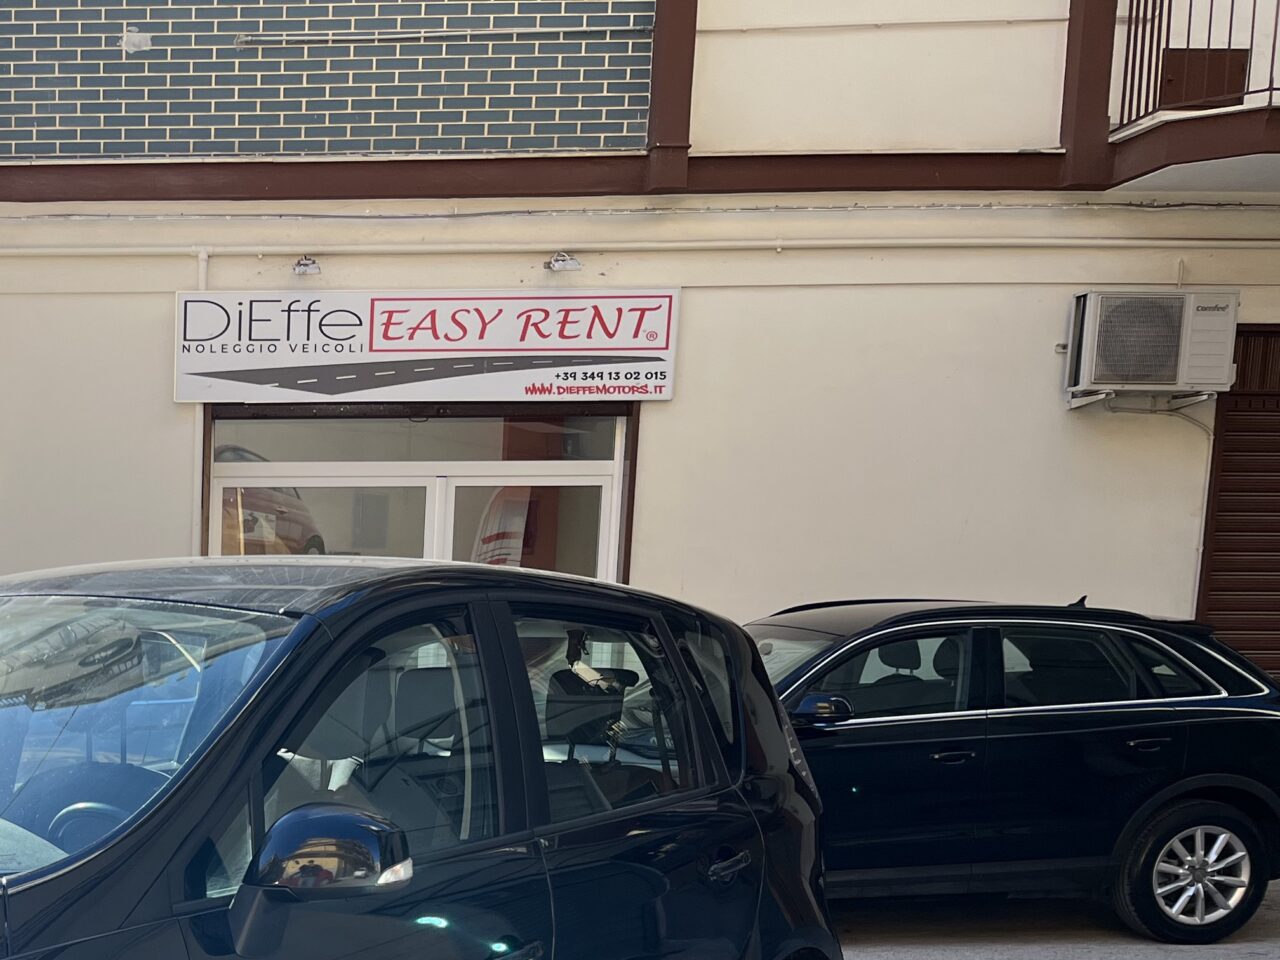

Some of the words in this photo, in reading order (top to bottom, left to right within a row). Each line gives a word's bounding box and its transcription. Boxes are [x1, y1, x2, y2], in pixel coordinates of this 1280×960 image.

[183, 299, 363, 342] DiEffe
[380, 307, 503, 342] EASY
[182, 343, 278, 353] NOLEGGIO
[289, 343, 364, 353] VEICOLI
[554, 371, 577, 381] +39
[581, 371, 604, 381] 349
[608, 371, 621, 381] 13
[624, 371, 641, 381] 02
[645, 371, 667, 381] 015
